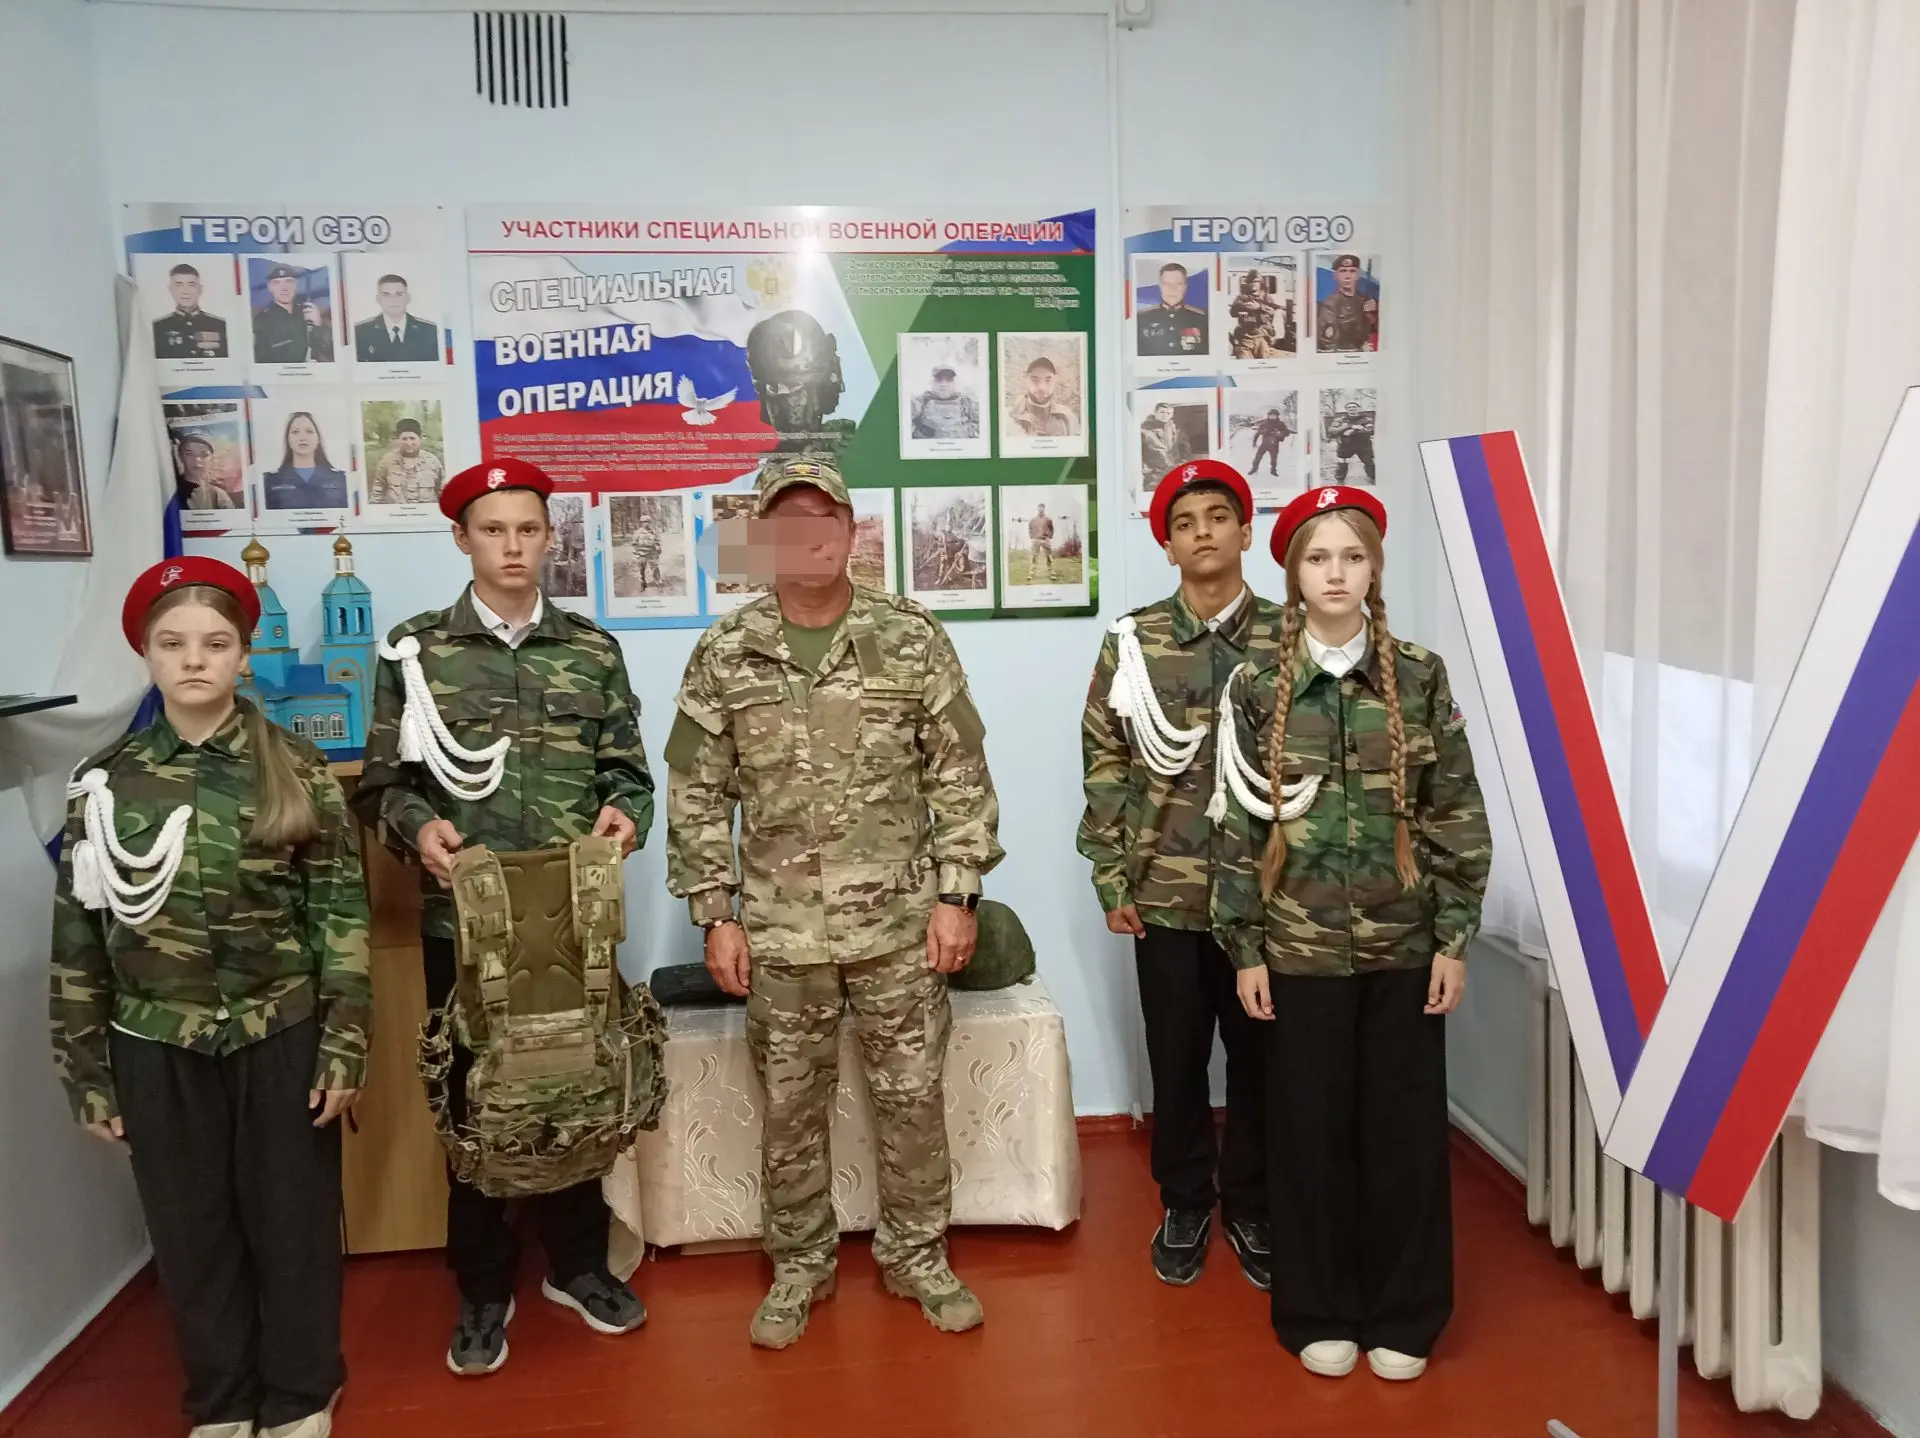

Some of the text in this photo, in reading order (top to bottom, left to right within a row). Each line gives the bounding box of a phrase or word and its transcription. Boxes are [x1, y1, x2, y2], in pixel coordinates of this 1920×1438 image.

[180, 215, 391, 245] ГЕРОИ СВО
[502, 220, 639, 239] УЧАСТНИКИ
[829, 218, 937, 240] ВОЕННОЙ
[944, 220, 1065, 244] ОПЕРАЦИИ
[1171, 215, 1354, 244] ГЕРОИ СВО
[489, 266, 735, 313] СПЕЦИАЛЬНАЯ
[494, 323, 652, 367] ВОЕННАЯ
[497, 371, 674, 418] ОПЕРАЦИЯ
